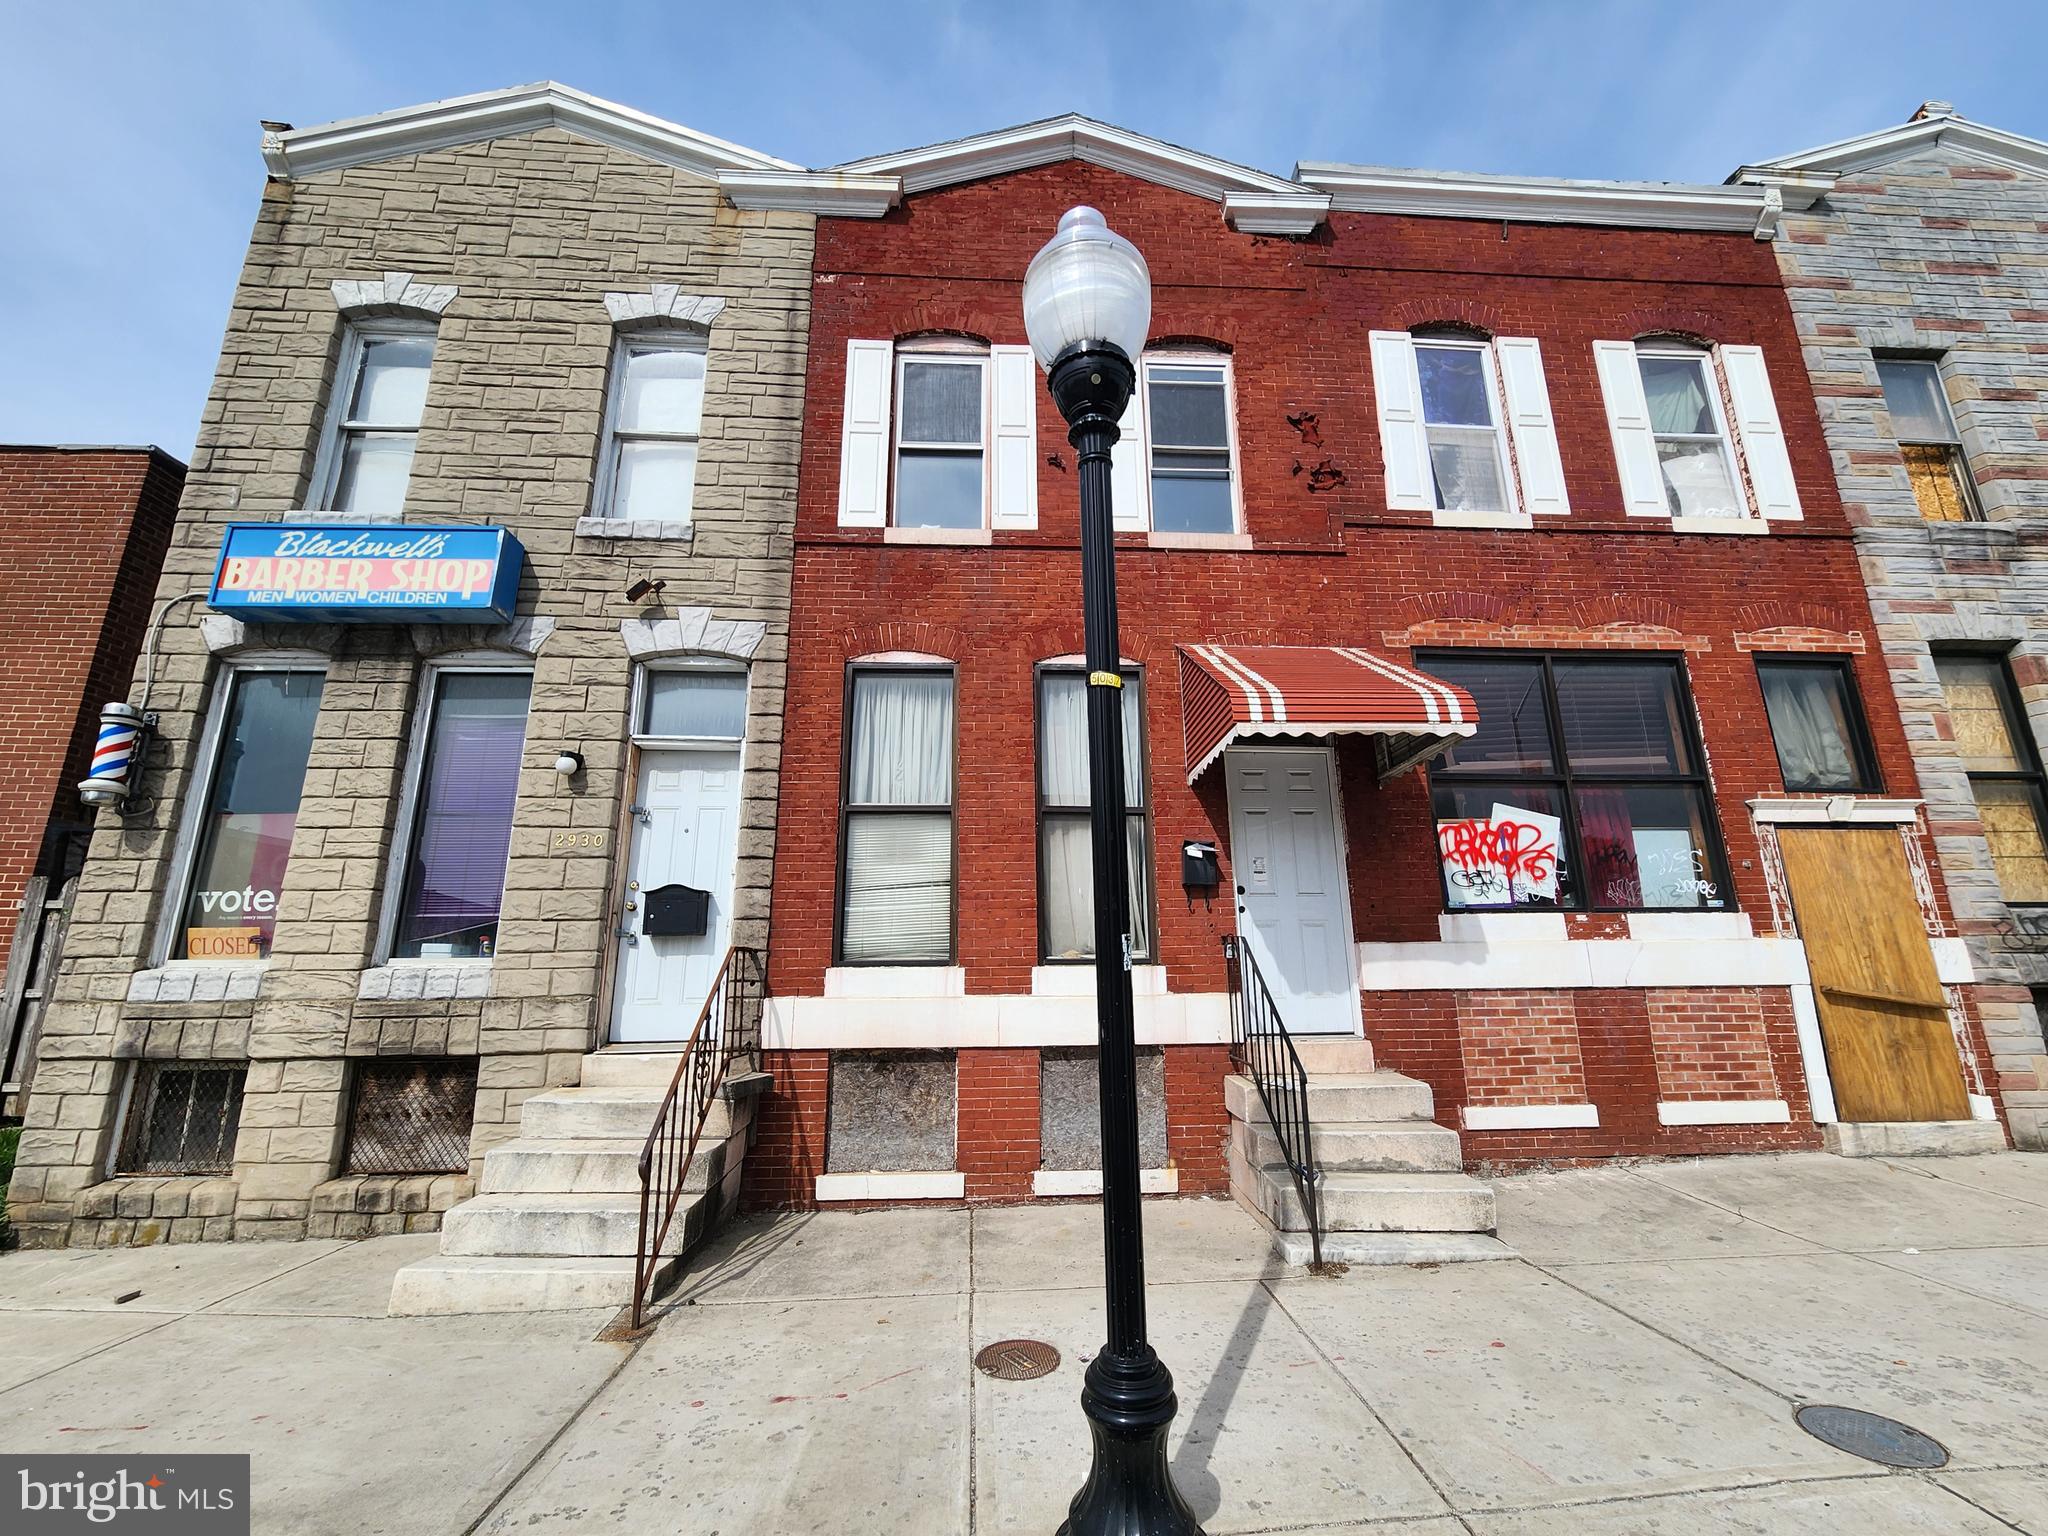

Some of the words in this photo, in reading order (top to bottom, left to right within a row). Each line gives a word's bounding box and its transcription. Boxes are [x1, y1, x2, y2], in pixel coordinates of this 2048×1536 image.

[275, 531, 451, 559] Blackwell's
[223, 557, 372, 599] BARBER
[389, 559, 490, 600] SHOP
[247, 591, 284, 603] MEN
[296, 591, 357, 603] WOMEN
[368, 591, 447, 604] CHILDREN
[555, 833, 603, 848] 2930
[190, 937, 258, 955] CLOSED
